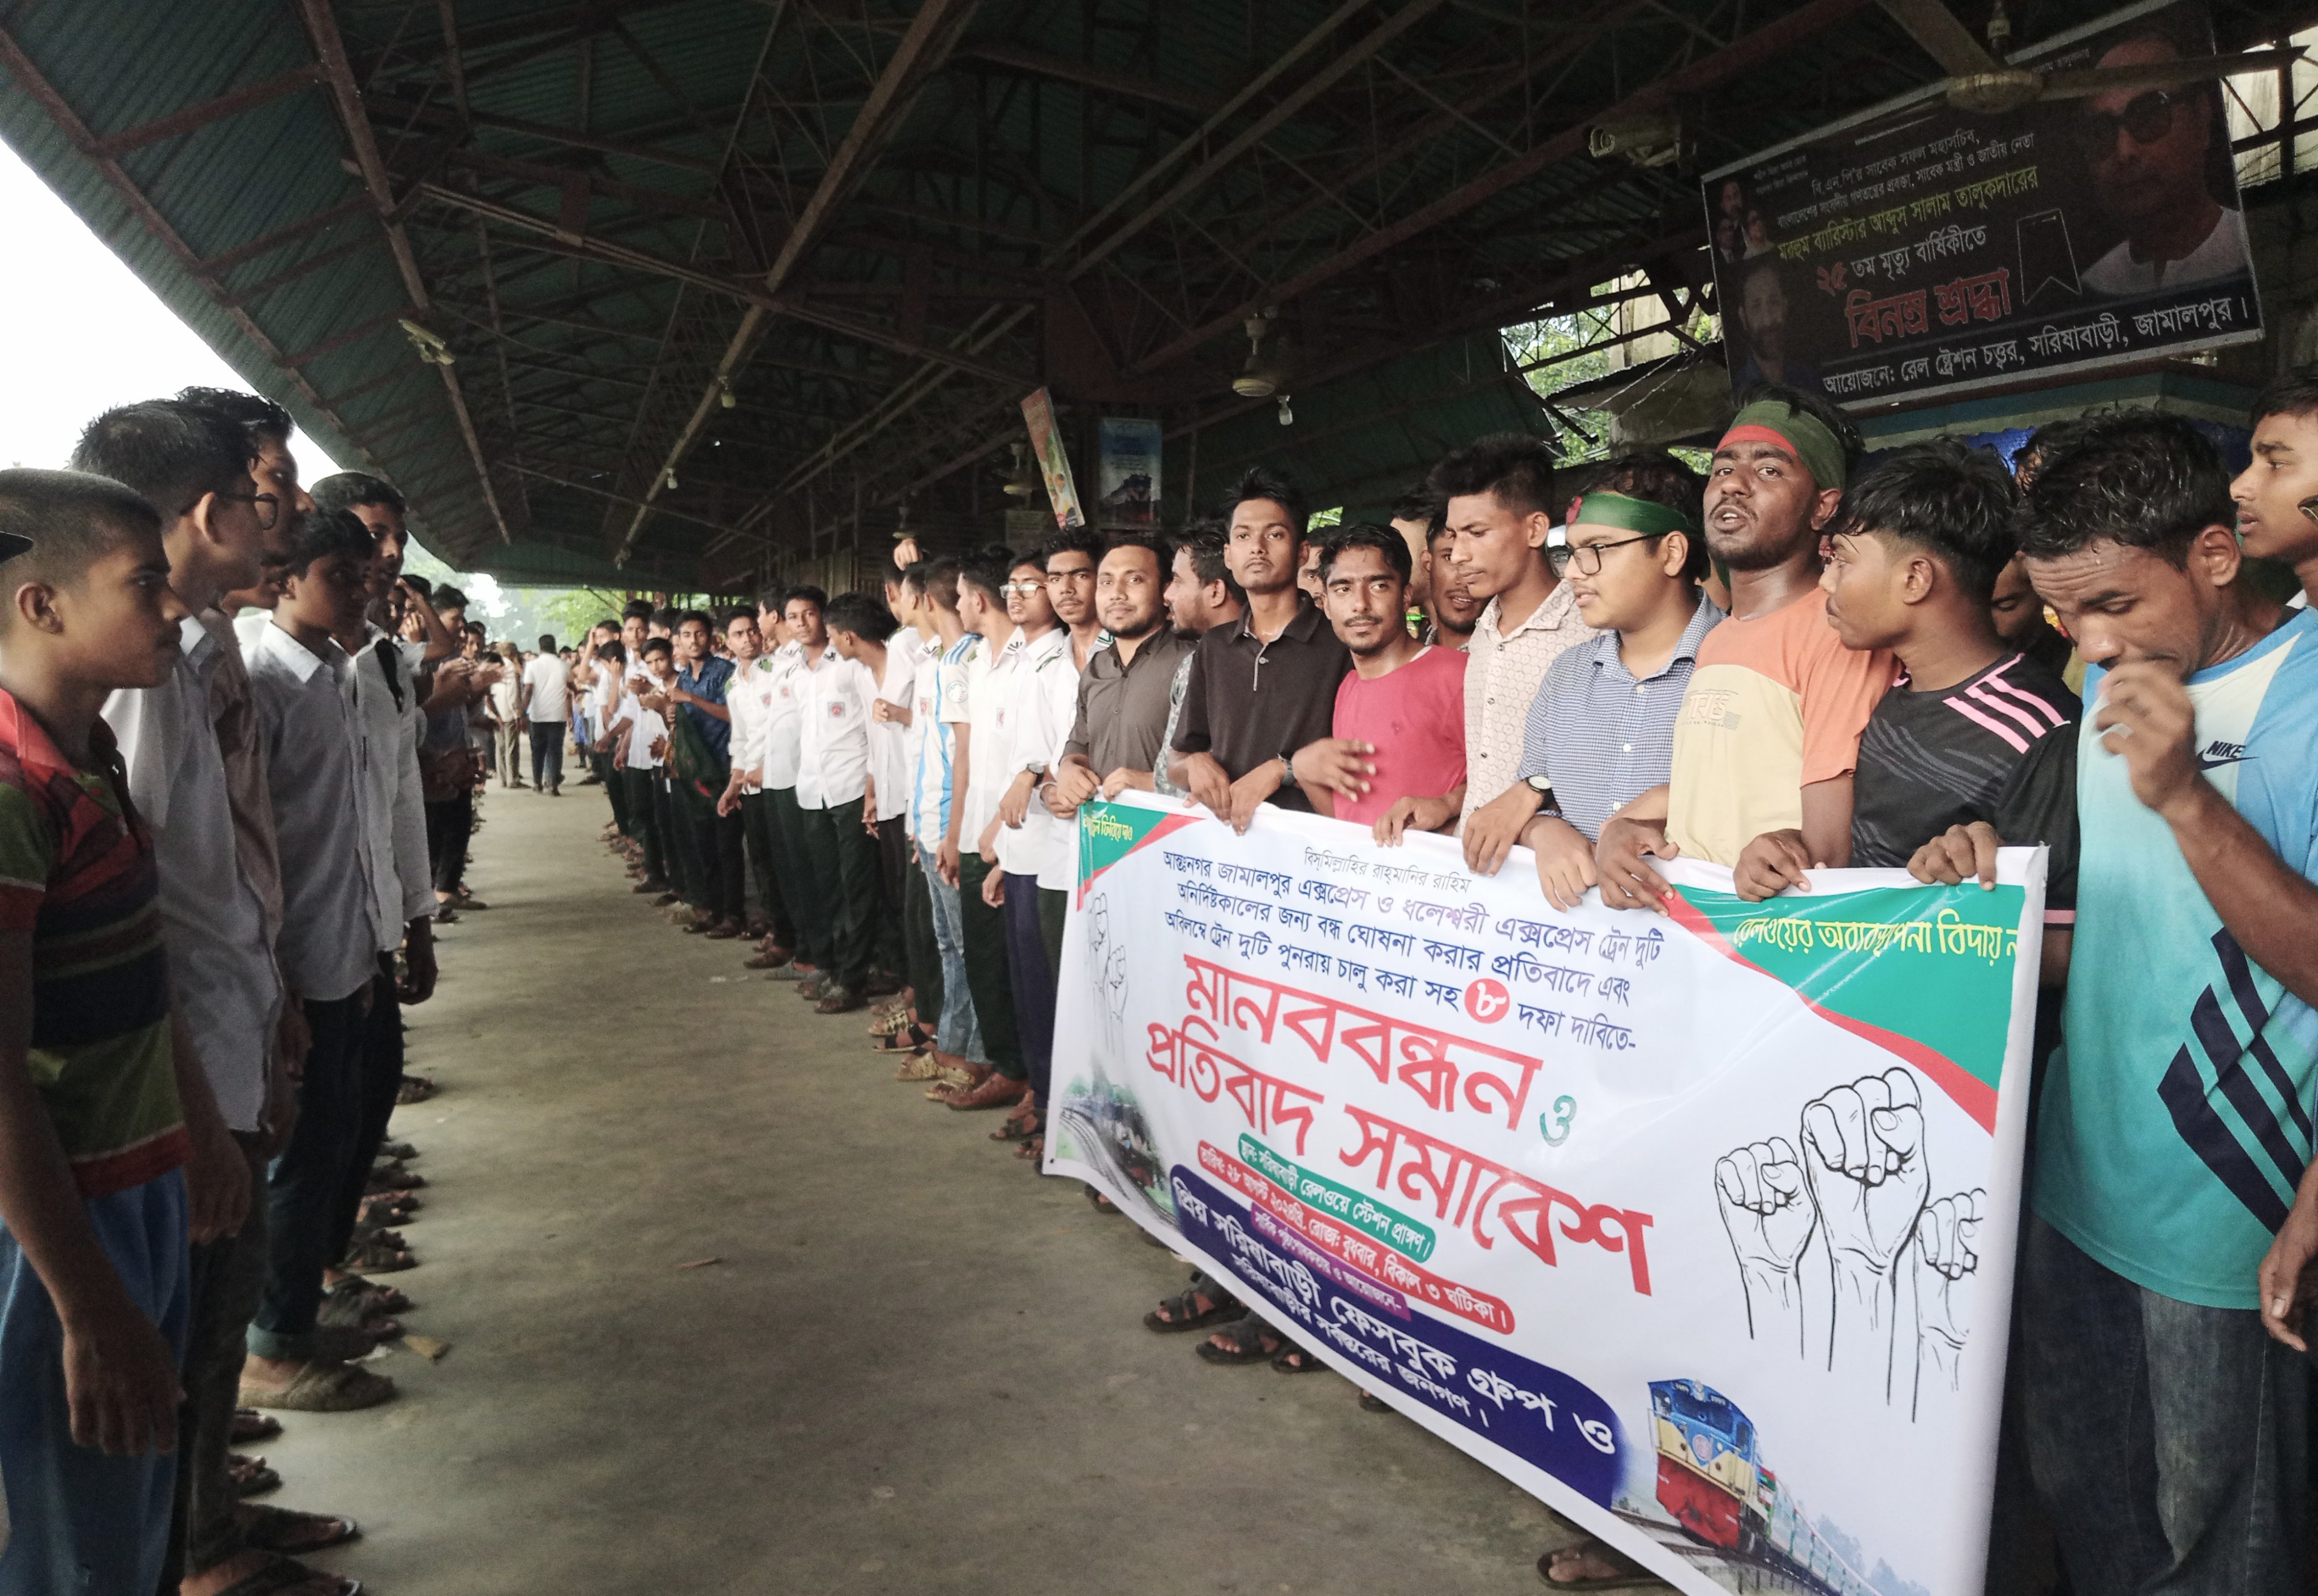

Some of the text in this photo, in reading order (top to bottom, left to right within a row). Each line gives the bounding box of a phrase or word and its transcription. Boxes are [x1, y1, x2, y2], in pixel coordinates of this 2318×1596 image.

[1945, 152, 1963, 171] মন্ত্রী
[1967, 153, 1974, 166] ও
[1976, 139, 2007, 162] জাতীয়
[2011, 132, 2034, 154] নেতা
[1909, 191, 1951, 221] সালাম
[1955, 166, 2038, 209] তালুকদারের
[1851, 255, 1875, 278] তম
[1879, 247, 1910, 281] মৃত্যু
[1913, 225, 1987, 263] বার্ষিকীতে
[1844, 266, 2011, 348] বিনম্র শ্রদ্ধা
[1901, 357, 1930, 381] রেল
[2027, 312, 2129, 356] সরিষাবাড়ী,
[2132, 297, 2232, 336] জামালপুর
[2206, 741, 2246, 758] NIKE
[1163, 851, 1665, 970] আন্তঃনগর জামালপুর এক্সপ্রেস ও ধলেশ্বরী এক্সপ্রেস ট্রেন দুটি
[1433, 871, 1472, 893] রাহিম
[1177, 880, 1630, 1006] অনির্দিষ্টকালের জন্য বন্ধ ঘোষনা করার প্রতিবাদে এবং
[1733, 917, 1814, 954] রেলওয়ের
[1814, 921, 1933, 957] অব্যবস্থাপনা
[1937, 908, 2003, 966] বিদায়
[1165, 909, 1636, 1051] অবিলম্বে ট্রেন দুটি পুনরায় চালু করা সহ ৮ দফা দাবিতে-
[1183, 953, 1577, 1147] মানববন্ধন ও
[1146, 1014, 1654, 1297] প্রতিবাদ সমাবেশ
[1300, 1178, 1352, 1215] রেলওয়ে
[1353, 1198, 1393, 1235] স্টেশন
[1384, 1253, 1422, 1294] বিকাল
[1426, 1283, 1441, 1300] ৩
[1210, 1208, 1321, 1309] সরিষাবাড়ী
[1330, 1296, 1458, 1380] ফেসবুক
[1466, 1367, 1558, 1432] গ্রুপ
[1572, 1412, 1616, 1455] ও
